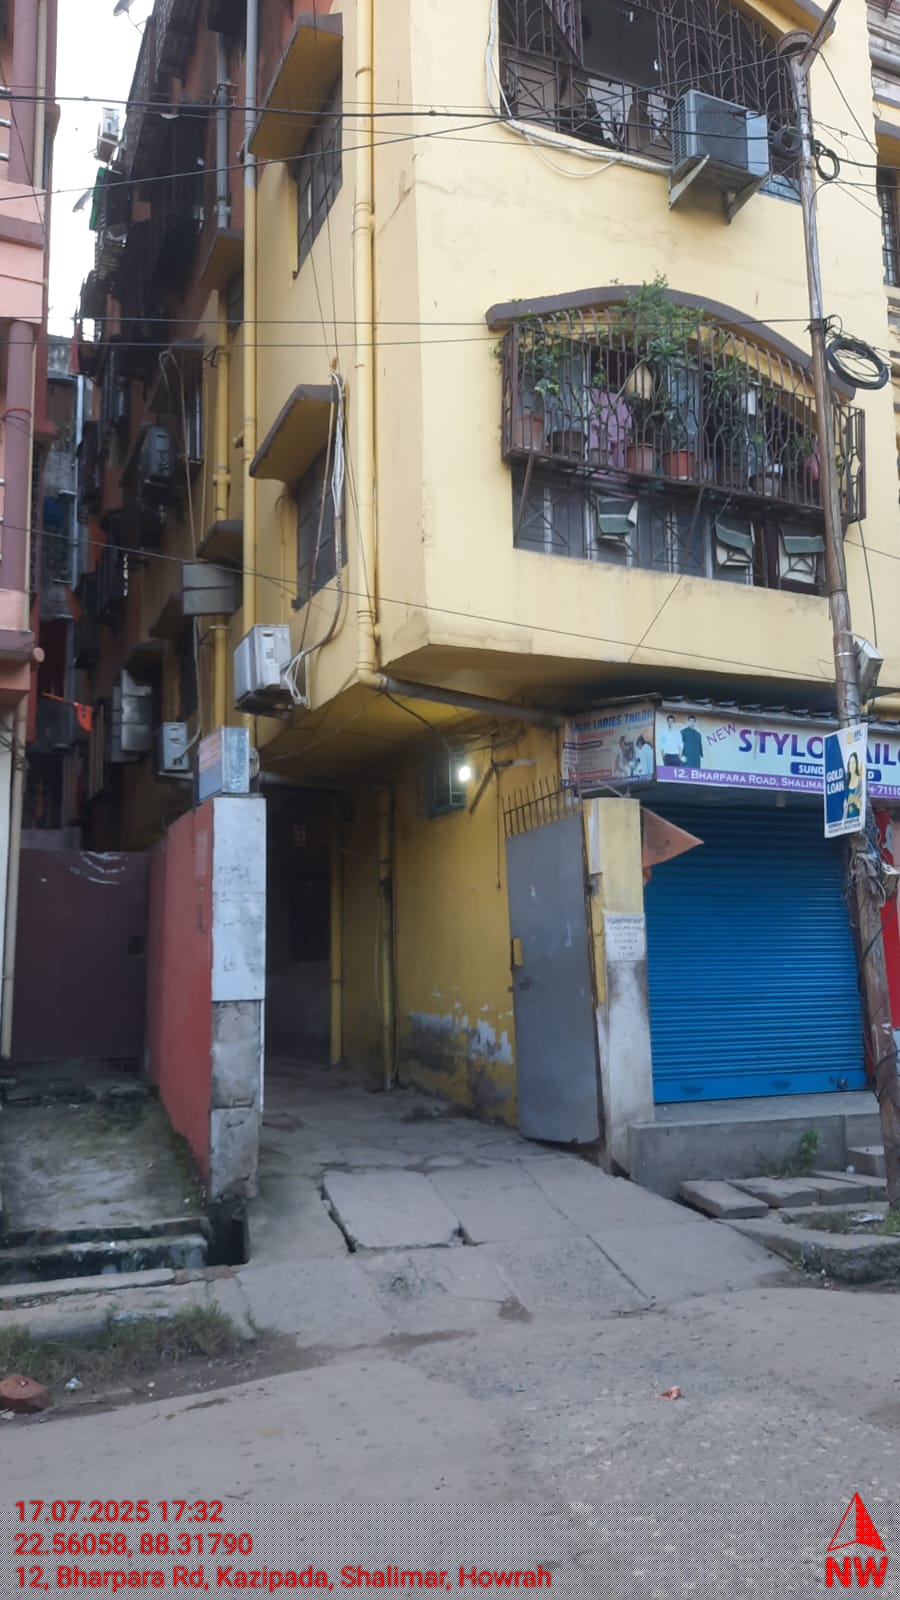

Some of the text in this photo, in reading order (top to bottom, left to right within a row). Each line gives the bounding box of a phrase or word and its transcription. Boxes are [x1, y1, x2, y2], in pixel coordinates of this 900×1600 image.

[593, 714, 622, 730] LADIES
[706, 721, 737, 746] NEW
[798, 764, 824, 775] SUND
[826, 767, 844, 783] GOLD
[690, 769, 747, 784] BHARPARA
[781, 777, 824, 790] SHALIMA
[826, 779, 845, 795] LOAN
